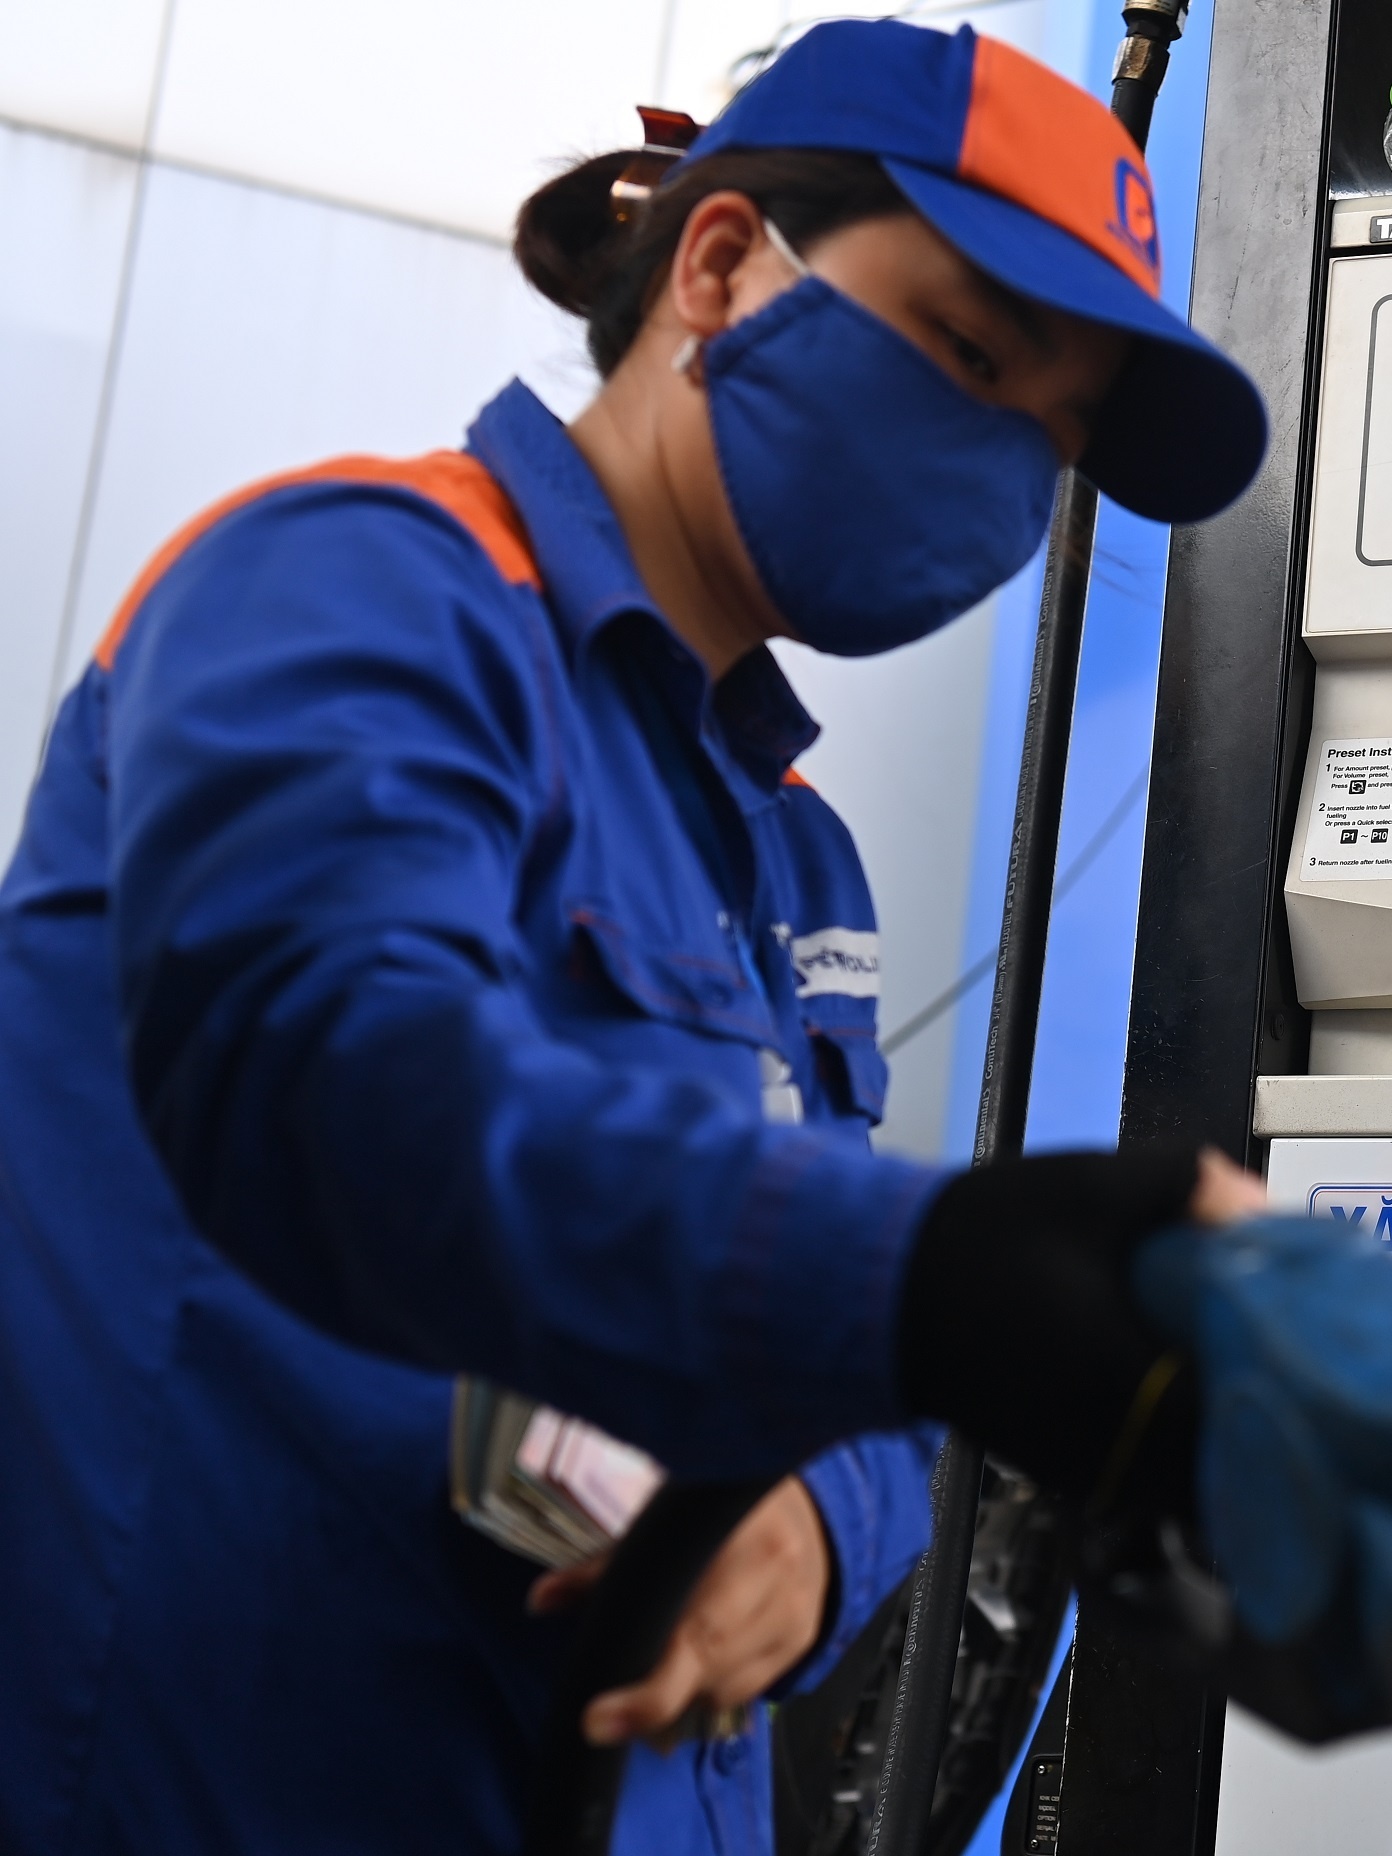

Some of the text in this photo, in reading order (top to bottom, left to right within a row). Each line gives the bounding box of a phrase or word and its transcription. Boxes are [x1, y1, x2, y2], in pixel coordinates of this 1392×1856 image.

[1327, 748, 1367, 759] Preset
[1326, 763, 1331, 772] 1
[1318, 803, 1326, 812] 2
[1342, 832, 1388, 841] P1 P10
[1309, 857, 1317, 866] 3
